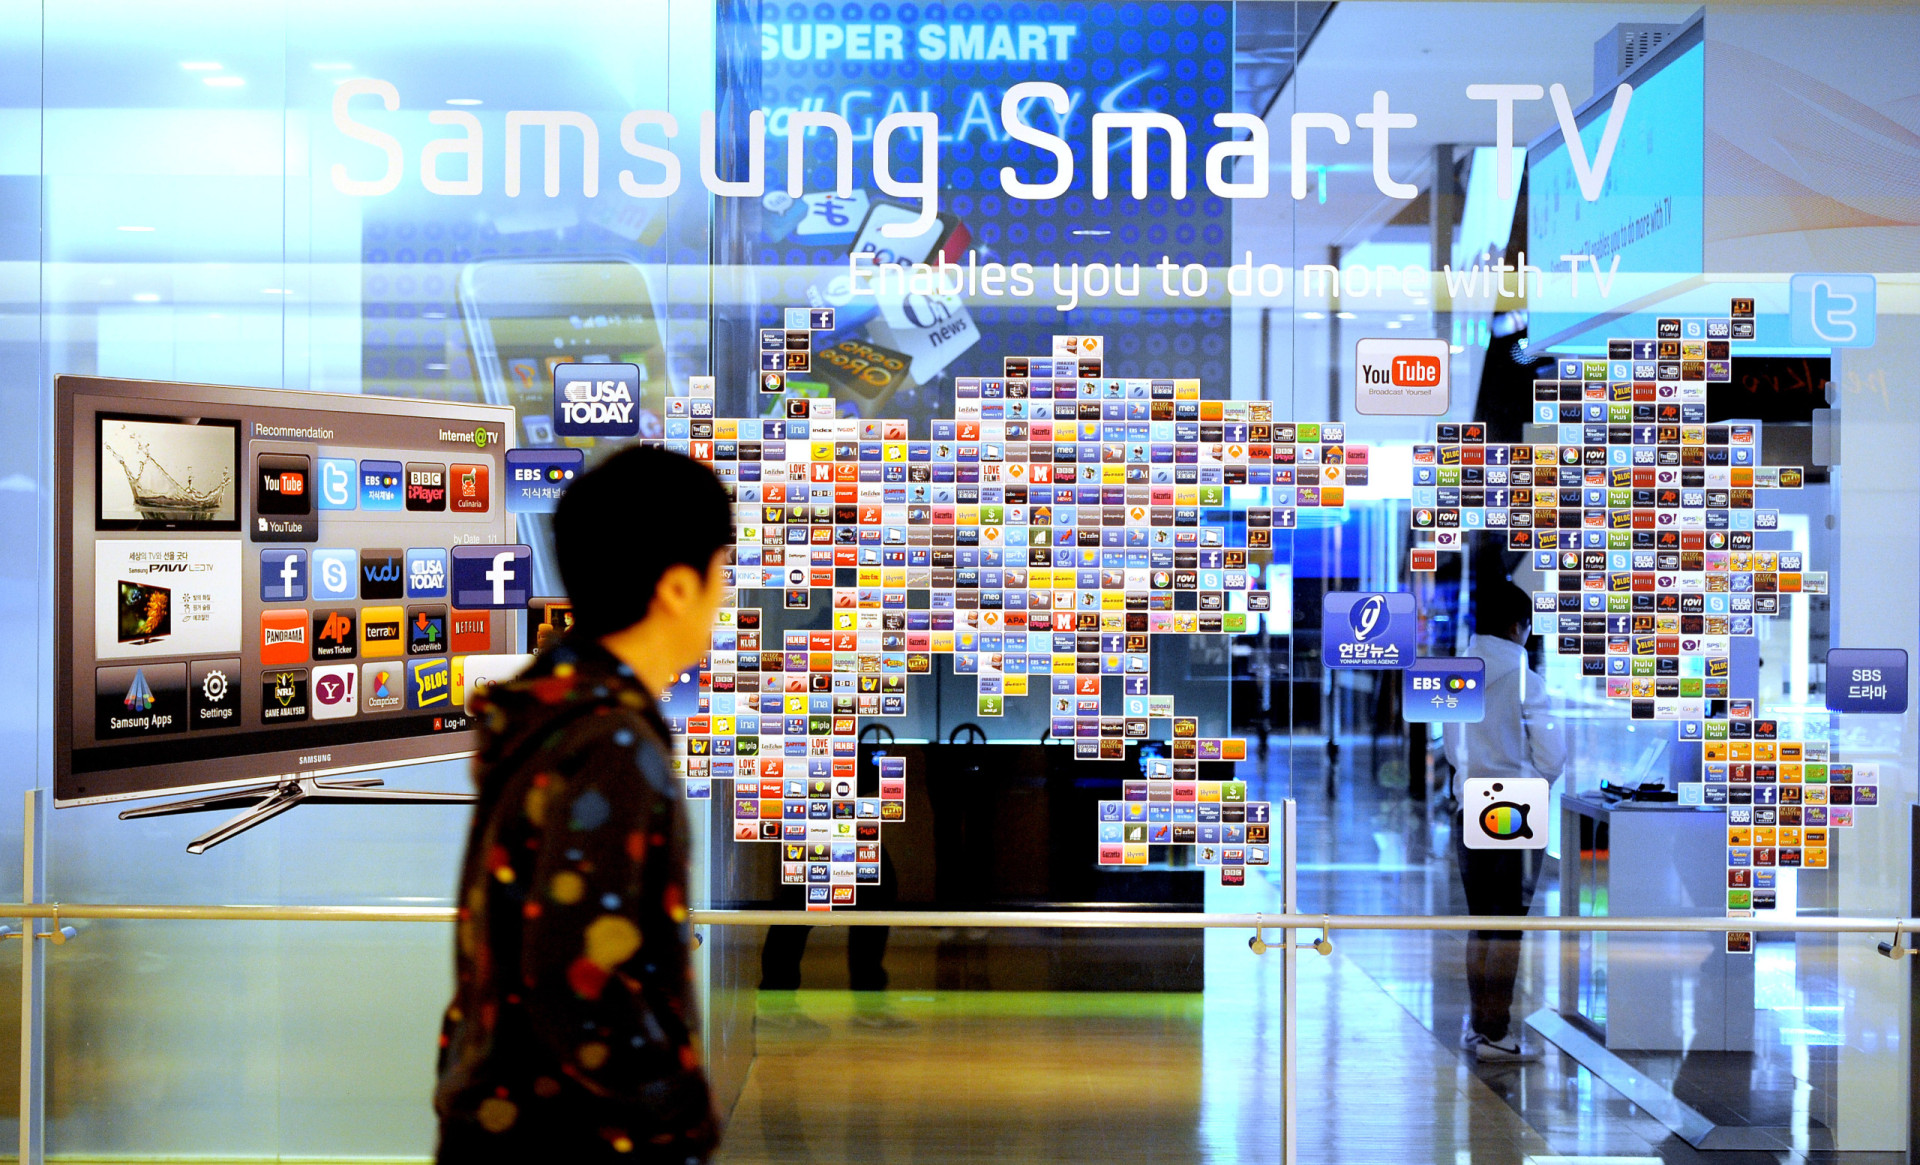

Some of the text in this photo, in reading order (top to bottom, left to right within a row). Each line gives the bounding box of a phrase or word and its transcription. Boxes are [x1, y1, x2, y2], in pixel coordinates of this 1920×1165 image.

[760, 23, 1077, 61] SUPER SMART
[841, 90, 1085, 143] GALAXY
[331, 79, 1633, 238] Samsung Smart TV
[850, 250, 1034, 297] Enables
[1053, 262, 1140, 311] you
[1156, 256, 1208, 297] to
[1227, 251, 1283, 298] do
[1303, 264, 1427, 298] more
[1444, 252, 1543, 299] with
[1560, 255, 1621, 298] TV
[928, 315, 967, 348] news
[1660, 323, 1679, 333] rovi
[1586, 364, 1605, 372] hulu
[583, 381, 631, 402] USA
[256, 423, 334, 439] Recommendation
[515, 469, 541, 481] EBS
[789, 464, 806, 473] LOVE
[1439, 469, 1458, 477] hulu
[365, 476, 380, 486] EBS
[411, 471, 441, 486] BBC
[408, 486, 444, 503] iPlayer
[458, 500, 482, 508] Culinaria
[270, 521, 303, 532] YouTube
[454, 534, 462, 545] by
[463, 534, 480, 544] Date
[128, 567, 148, 575] Samsung
[364, 556, 400, 582] vudu
[420, 560, 443, 575] USA
[1609, 596, 1628, 604] hulu
[319, 611, 351, 644] AP
[455, 620, 484, 634] NETFLIX
[266, 629, 303, 643] PANORAMA
[317, 646, 352, 655] News Ticker
[1338, 643, 1399, 658] 연합뉴스
[1852, 669, 1882, 682] SBS
[1413, 677, 1441, 690] EBS
[276, 688, 294, 697] NRL
[1848, 685, 1887, 700] 드라마
[1430, 694, 1459, 708] 수능
[200, 708, 232, 719] Settings
[265, 706, 305, 717] GAME ANALYSER
[110, 714, 172, 730] Samsung Apps
[444, 718, 466, 728] Log-in
[299, 753, 332, 765] SAMSUNG
